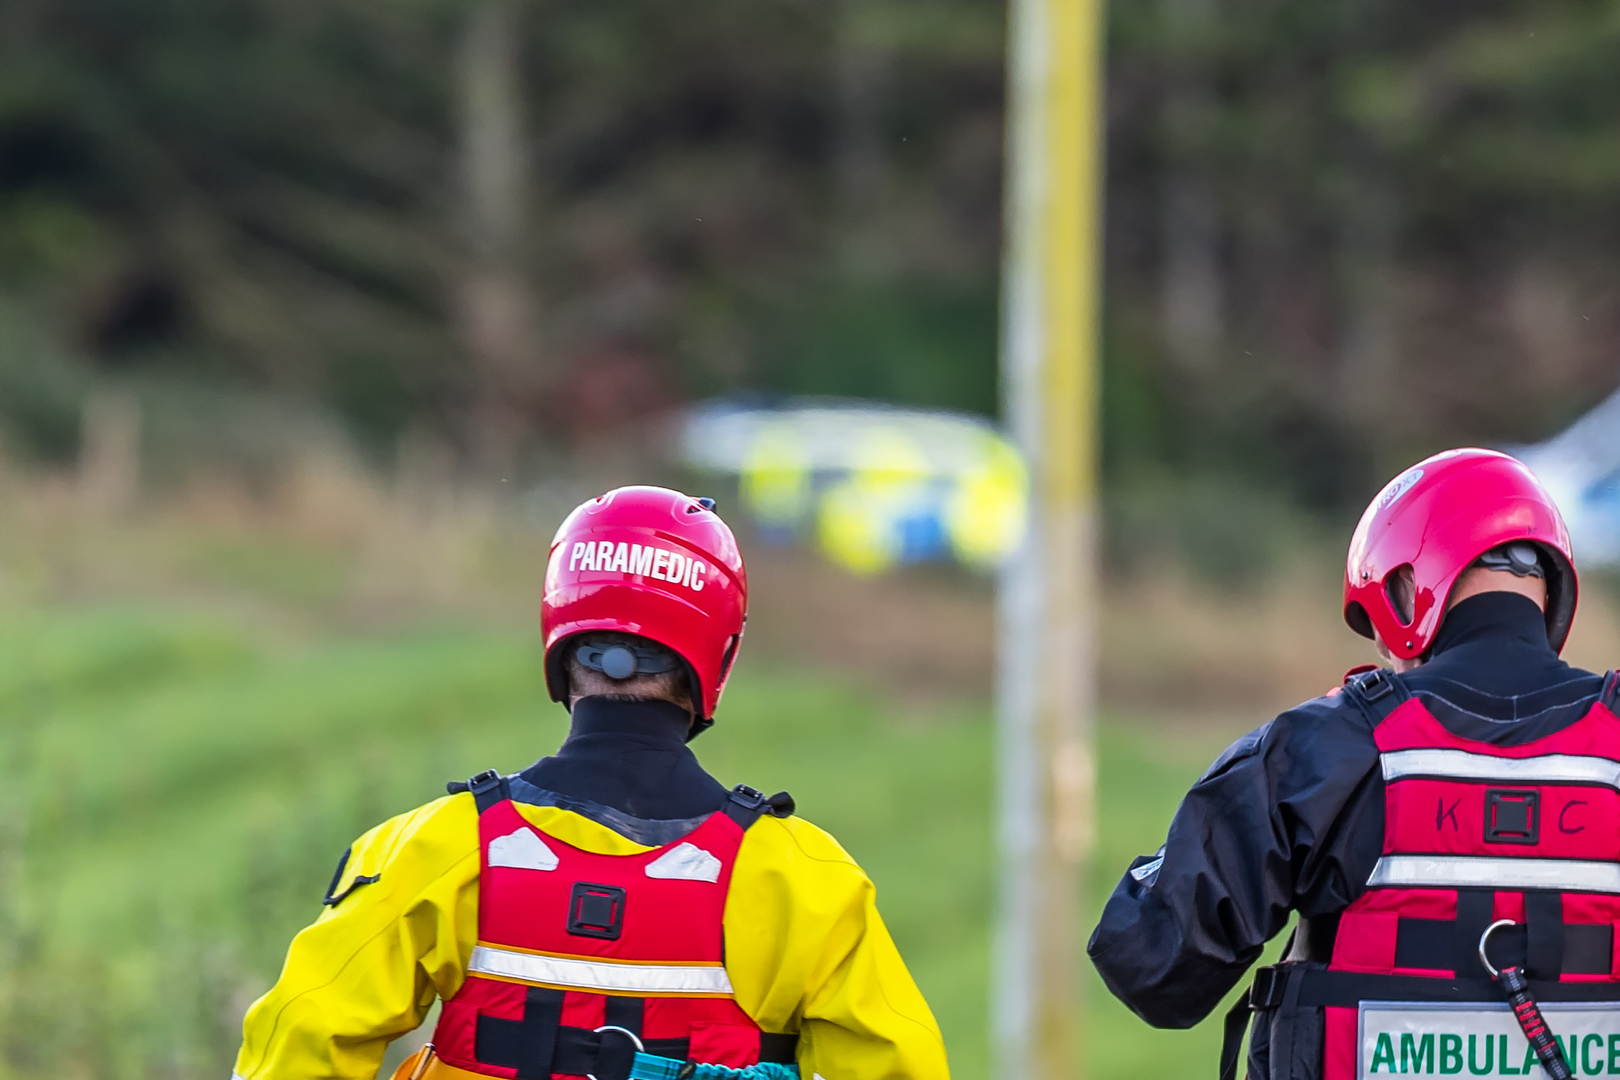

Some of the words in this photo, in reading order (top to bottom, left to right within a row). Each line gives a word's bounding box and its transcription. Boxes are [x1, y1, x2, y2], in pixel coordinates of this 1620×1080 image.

[569, 541, 706, 592] PARAMEDIC
[1436, 798, 1462, 831] K
[1558, 800, 1588, 834] C
